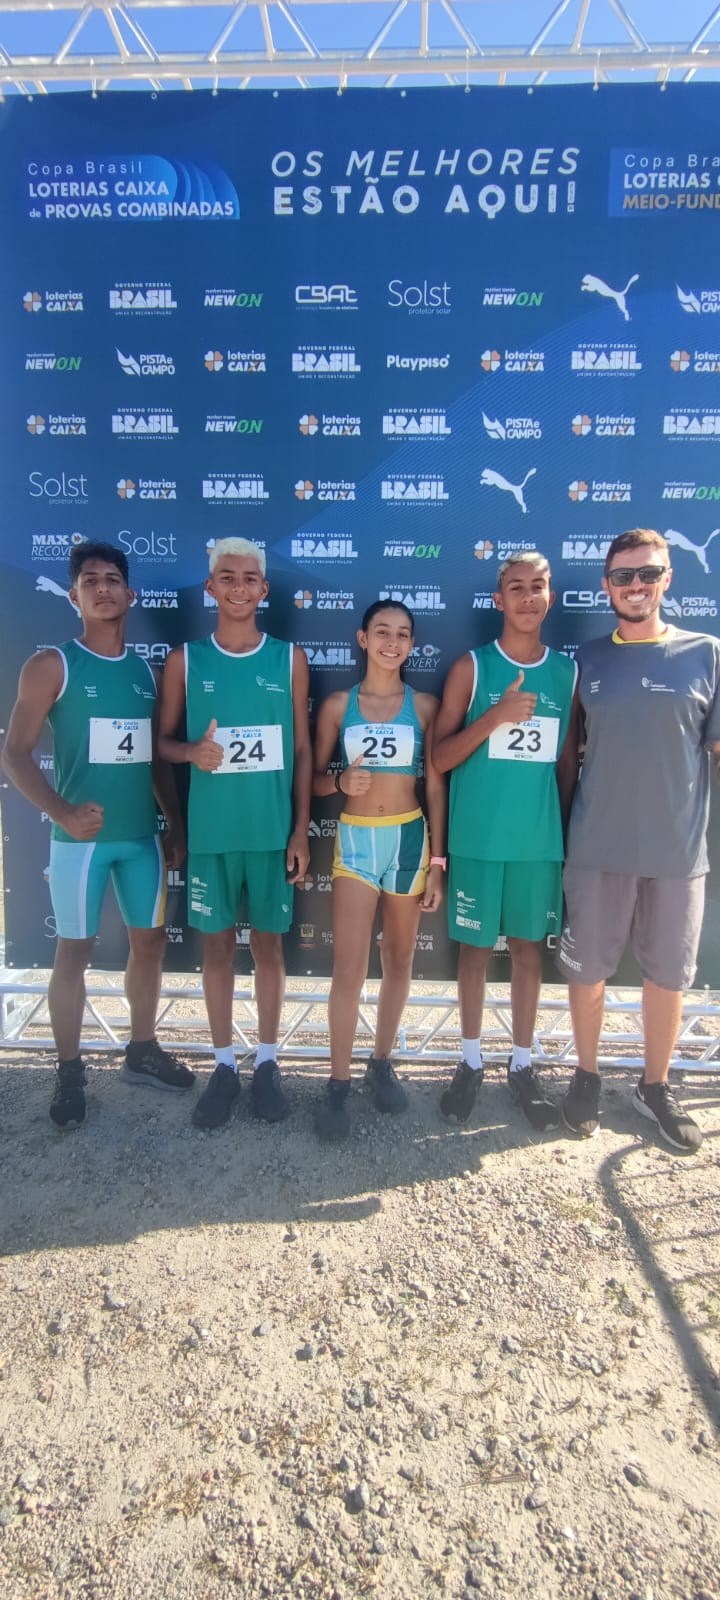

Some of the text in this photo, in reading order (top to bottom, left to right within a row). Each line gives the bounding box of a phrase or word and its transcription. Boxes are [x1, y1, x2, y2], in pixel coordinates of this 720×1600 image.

[271, 147, 580, 177] OS MELHORES
[625, 154, 674, 170] Copa
[28, 160, 142, 177] Copa Brasil
[624, 172, 710, 189] LOTERIAS
[29, 181, 169, 197] LOTERIAS CAIXA
[274, 177, 576, 218] ESTÃO AQUI!
[30, 201, 234, 218] de PROVAS COMBINADAS
[46, 291, 83, 301] loterias
[109, 290, 177, 308] BRASIL
[388, 280, 451, 307] Solst
[46, 301, 84, 312] CAIXA
[228, 350, 266, 360] loterias
[505, 350, 544, 360] loterias
[571, 351, 642, 370] BRASIL
[228, 361, 266, 372] CAIXA
[292, 353, 361, 372] BRASIL
[387, 354, 450, 371] Playpiso
[505, 361, 544, 371] CAIXA
[141, 365, 175, 375] CAMPO
[49, 414, 86, 423] loterias
[112, 415, 179, 433] BRASIL
[322, 414, 361, 424] loterias
[596, 414, 636, 425] loterias
[49, 425, 86, 435] CAIXA
[322, 425, 361, 436] CAIXA
[383, 416, 451, 434] BRASIL
[595, 425, 635, 436] CAIXA
[507, 429, 542, 439] CAMPO
[29, 472, 88, 497] Solst
[139, 479, 176, 488] loterias
[203, 480, 269, 498] BRASIL
[318, 480, 355, 489] loterias
[592, 480, 632, 490] loterias
[139, 489, 176, 499] CAIXA
[318, 491, 355, 500] CAIXA
[381, 481, 449, 499] BRASIL
[592, 491, 631, 502] CAIXA
[32, 535, 69, 545] MAX
[118, 530, 177, 556] Solst
[498, 540, 536, 550] loterias
[291, 540, 358, 557] BRASIL
[141, 589, 178, 598] loterias
[317, 590, 354, 599] loterias
[142, 599, 178, 608] CAIXA
[317, 600, 354, 609] CAIXA
[682, 607, 717, 616] CAMPO
[303, 649, 356, 665] RASIL
[118, 733, 134, 754] 4
[508, 729, 542, 752] 23
[229, 740, 266, 763] 24
[362, 737, 397, 758] 25
